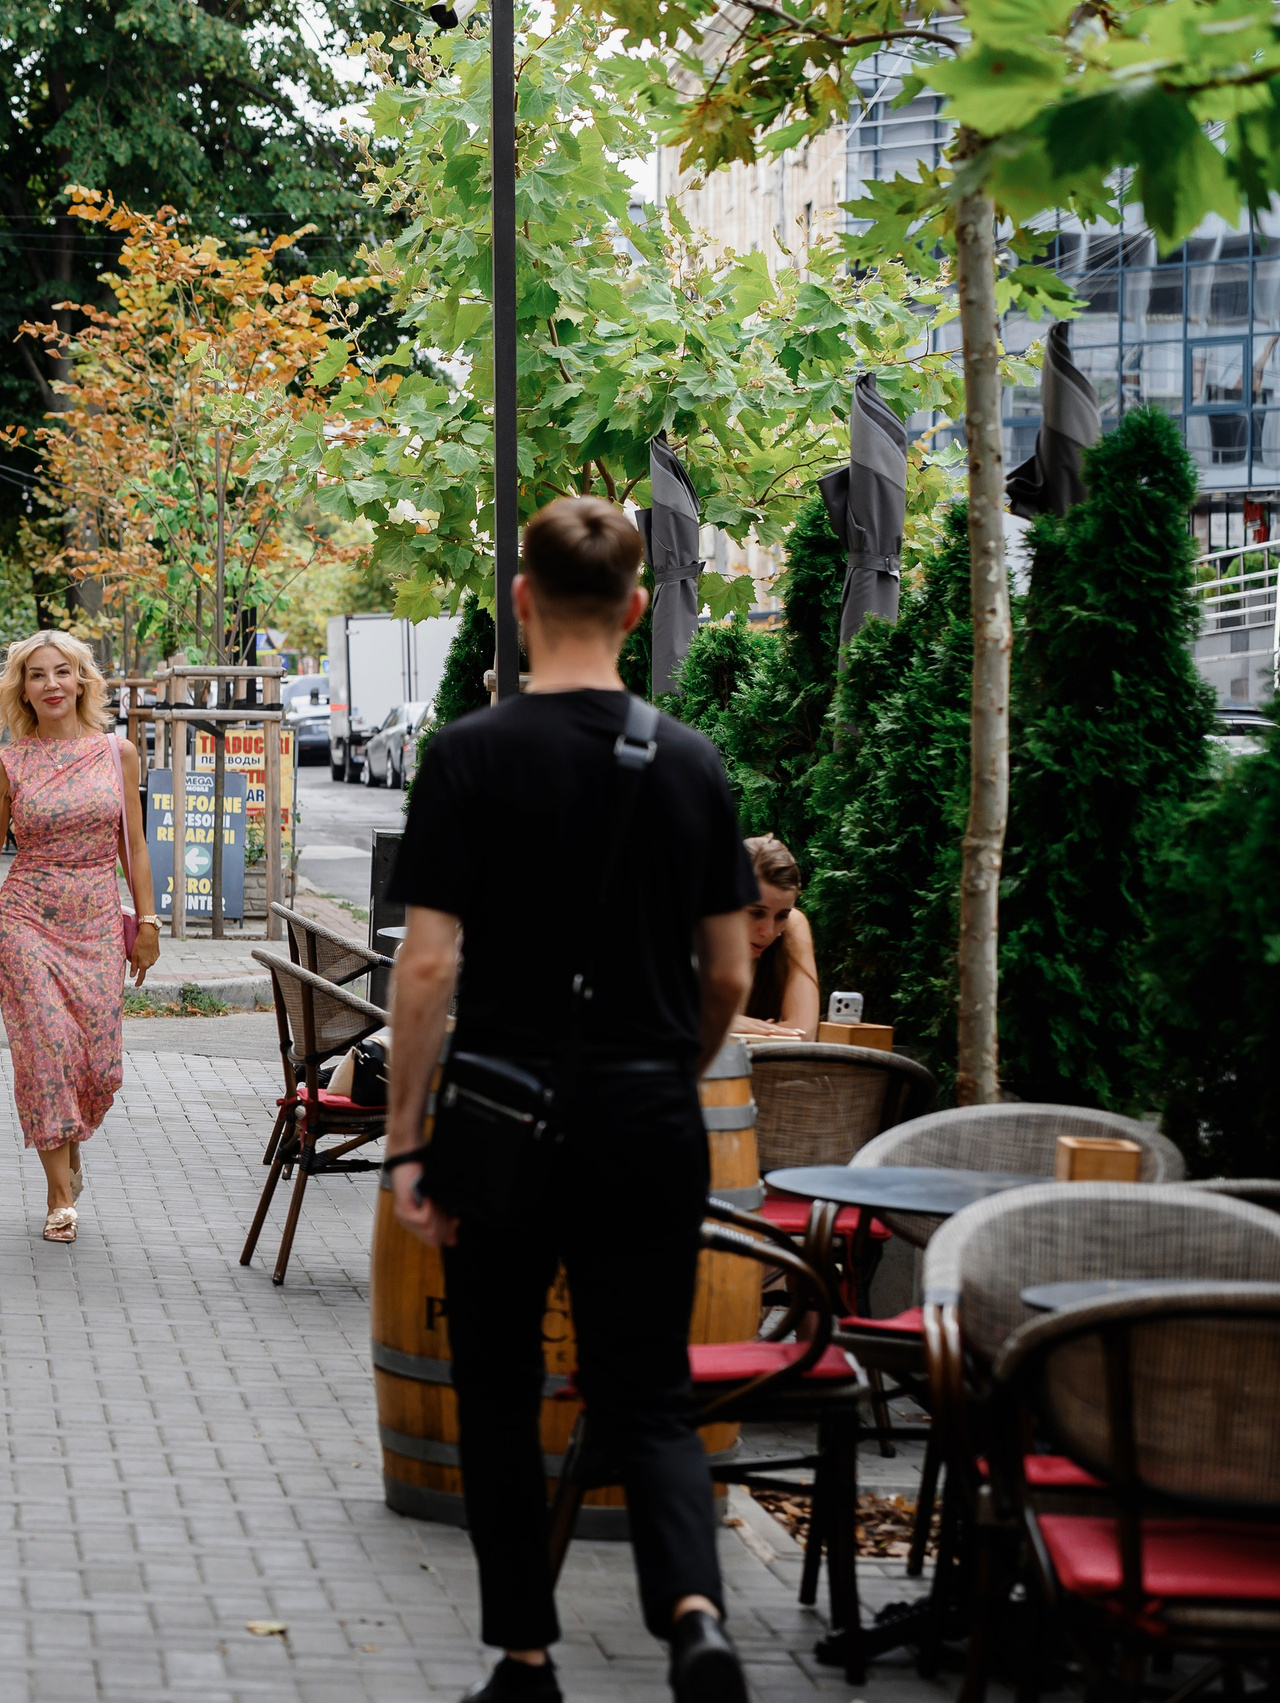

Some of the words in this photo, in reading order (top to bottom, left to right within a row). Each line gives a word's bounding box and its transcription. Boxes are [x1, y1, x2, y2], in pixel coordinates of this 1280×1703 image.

[200, 736, 290, 754] TADUCI
[201, 756, 261, 765] ПЕЕВОДЫ
[152, 793, 242, 814] TEFOANE
[163, 812, 231, 828] AESOII
[157, 826, 235, 844] REARAII
[166, 876, 214, 895] XRO
[161, 894, 226, 912] PNTER
